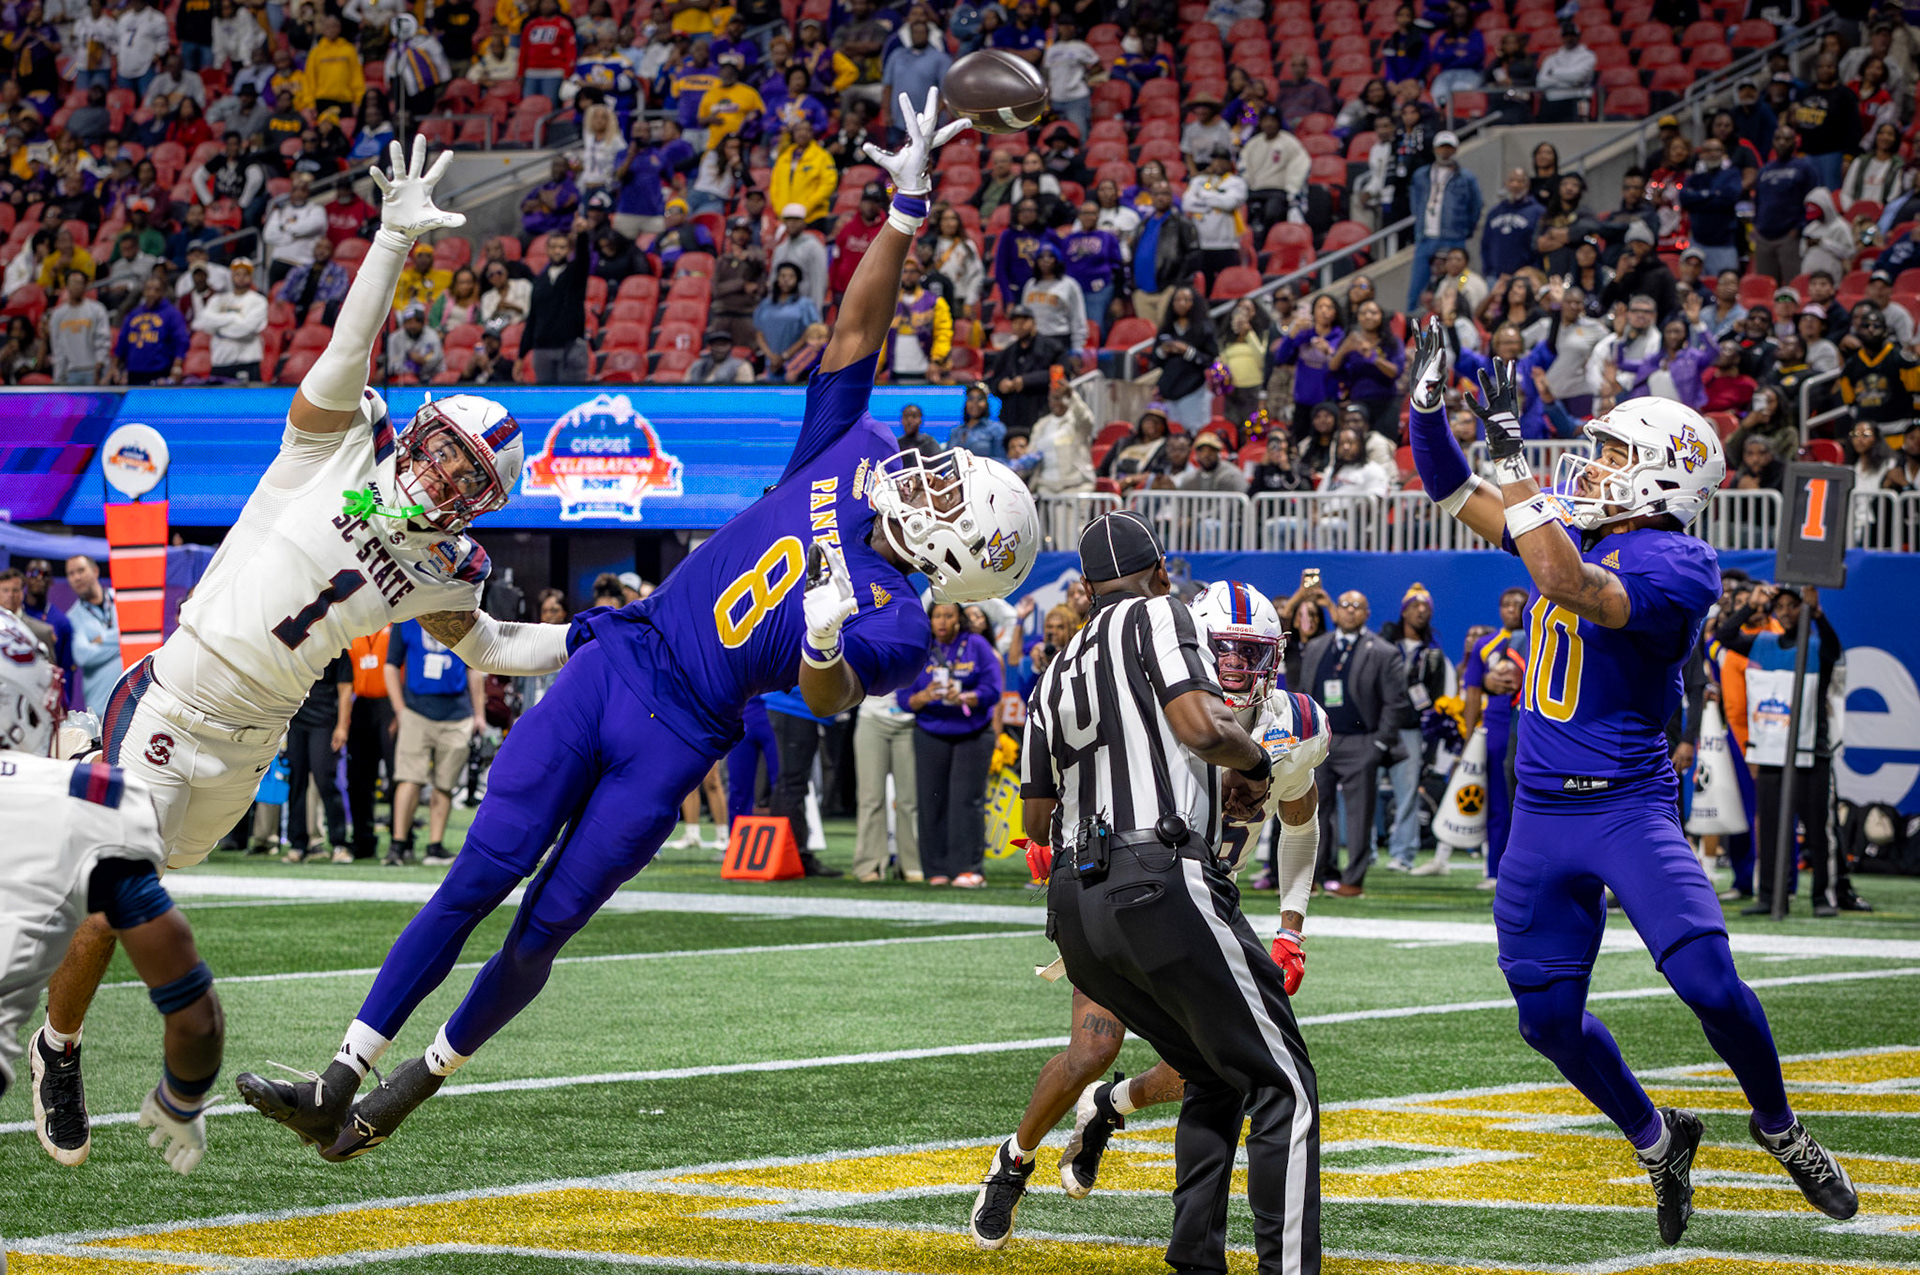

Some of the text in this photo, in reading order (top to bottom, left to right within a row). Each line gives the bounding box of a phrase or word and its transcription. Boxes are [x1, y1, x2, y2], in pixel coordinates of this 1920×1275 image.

[471, 433, 495, 461] Riddell
[570, 434, 631, 454] cricket
[1800, 477, 1830, 542] 1
[355, 536, 416, 608] STATE
[713, 535, 807, 649] 8
[271, 569, 367, 650] 1
[1525, 594, 1585, 723] 10
[733, 825, 776, 871] 10
